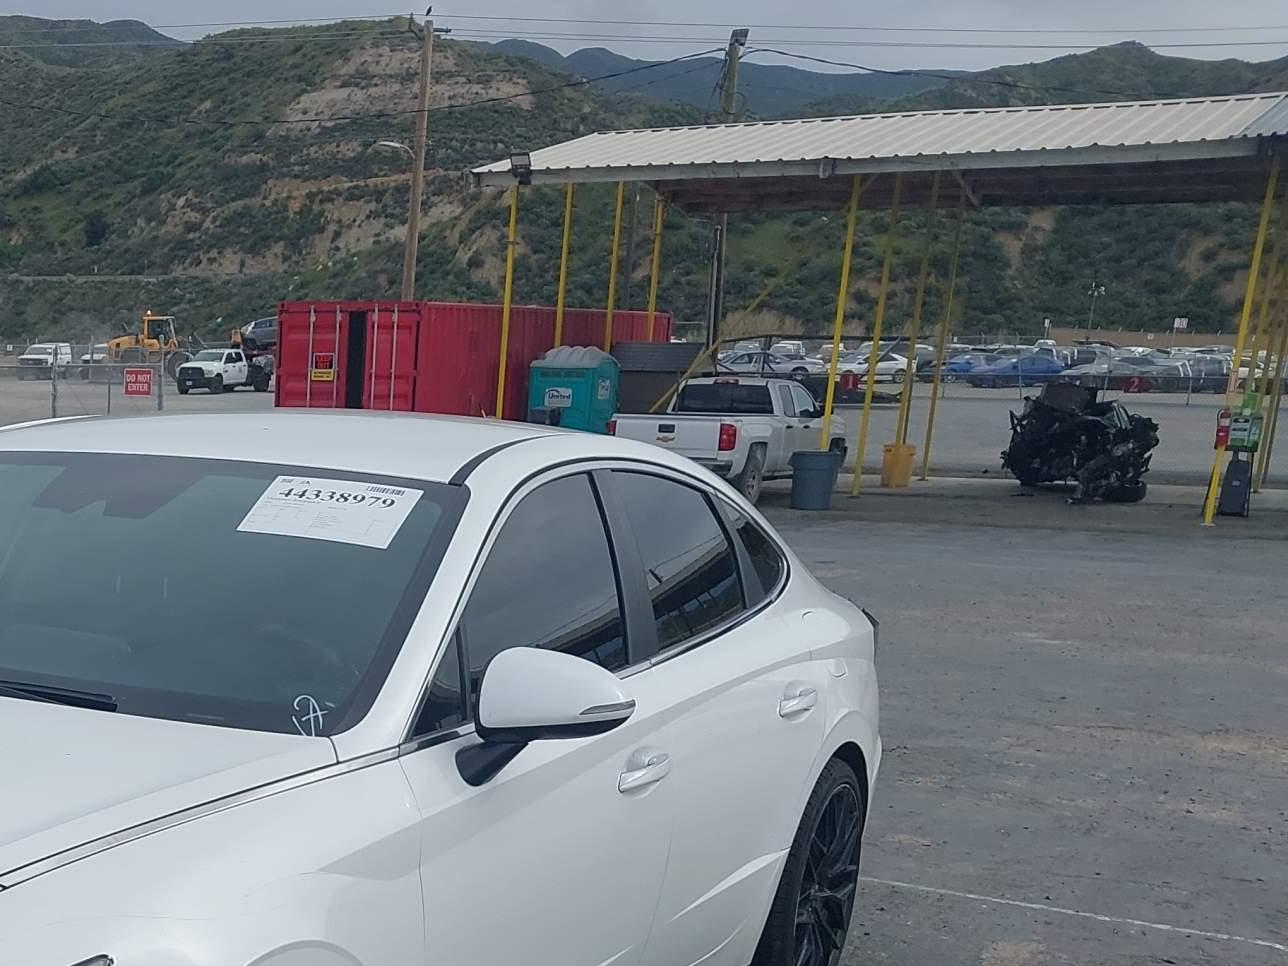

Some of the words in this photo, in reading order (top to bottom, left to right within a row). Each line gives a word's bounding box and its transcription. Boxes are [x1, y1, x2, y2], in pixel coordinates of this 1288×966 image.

[126, 374, 136, 382] DO
[137, 374, 150, 382] NOT
[127, 383, 149, 391] ENTER
[1128, 377, 1140, 392] 2
[547, 392, 571, 400] United
[279, 487, 396, 509] 44338979
